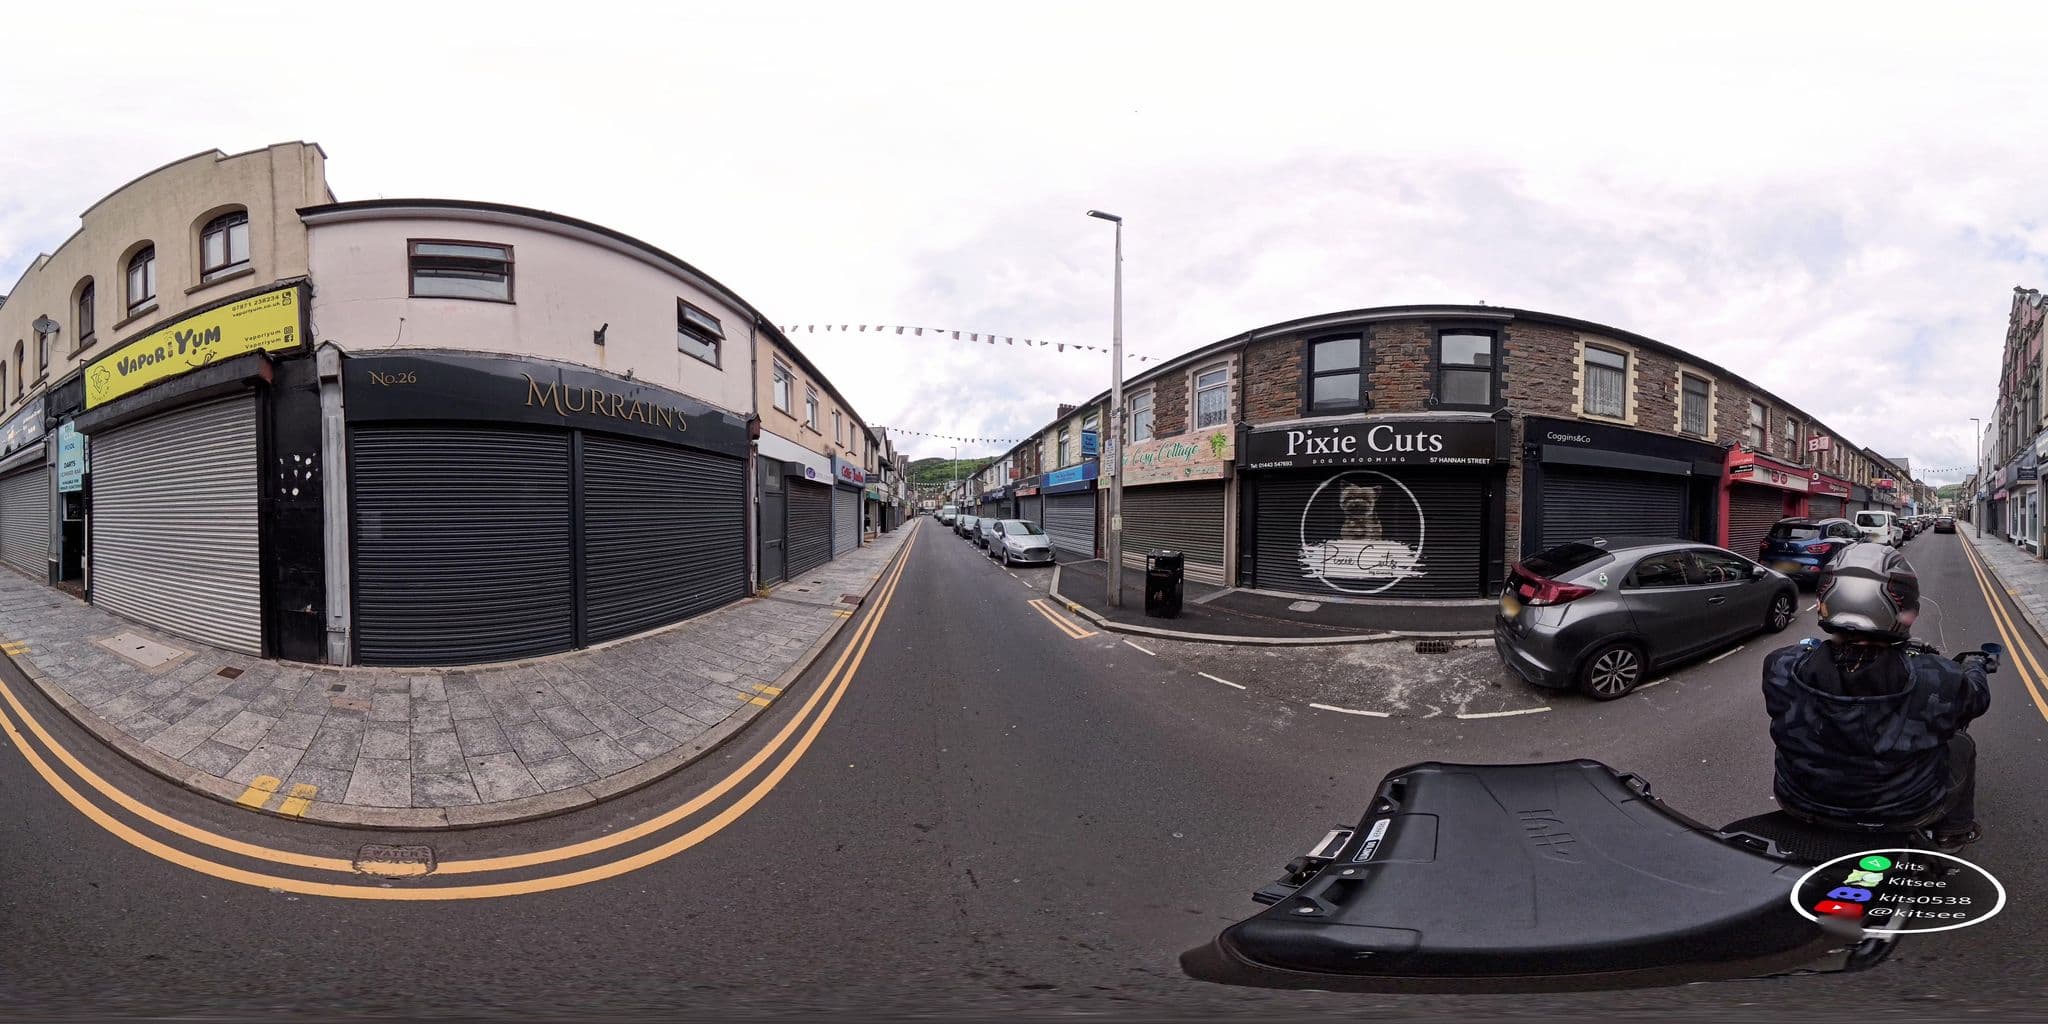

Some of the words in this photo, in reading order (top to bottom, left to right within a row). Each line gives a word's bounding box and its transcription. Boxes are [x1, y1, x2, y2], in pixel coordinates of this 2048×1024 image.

[368, 370, 417, 386] No.26
[1286, 427, 1357, 456] Pixie
[1367, 425, 1443, 453] Cuts
[1547, 431, 1591, 443] Coggins&Co
[1158, 440, 1199, 462] Cottage
[1467, 457, 1491, 465] STREET
[1319, 540, 1354, 576] Pixie
[1357, 544, 1398, 571] Cuts
